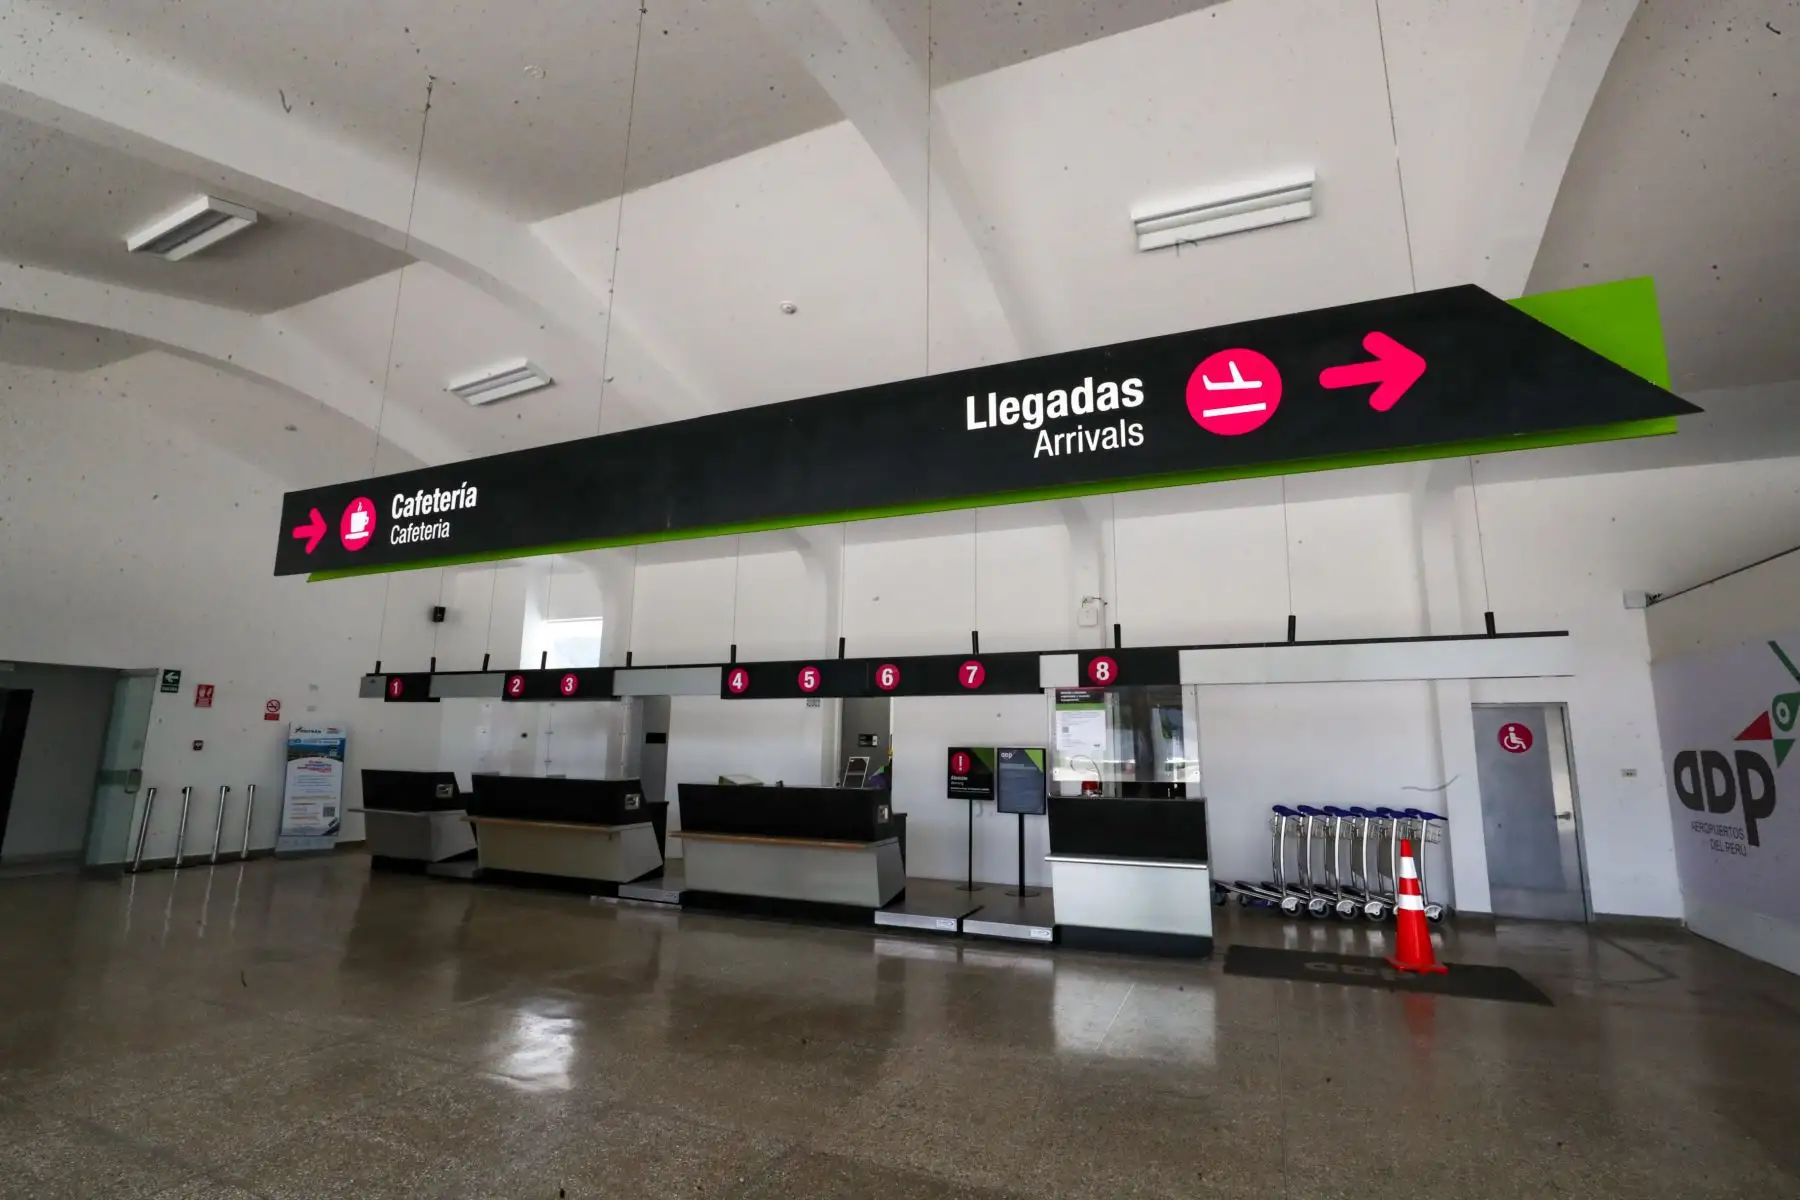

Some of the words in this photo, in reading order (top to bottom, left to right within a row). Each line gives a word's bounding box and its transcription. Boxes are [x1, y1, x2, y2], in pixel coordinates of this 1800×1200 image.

[966, 376, 1144, 430] Llegadas
[1033, 418, 1144, 459] Arrivals
[391, 481, 478, 520] Cafetería
[390, 518, 450, 545] Cafeteria
[803, 670, 816, 689] 5
[881, 667, 894, 686] 6
[966, 665, 978, 684] 7
[1096, 661, 1110, 681] 8
[393, 681, 400, 695] 1
[511, 678, 521, 693] 2
[564, 677, 575, 692] 3
[732, 672, 743, 690] 4
[1691, 820, 1745, 841] AEROPUERTOS
[1709, 838, 1725, 852] DEL
